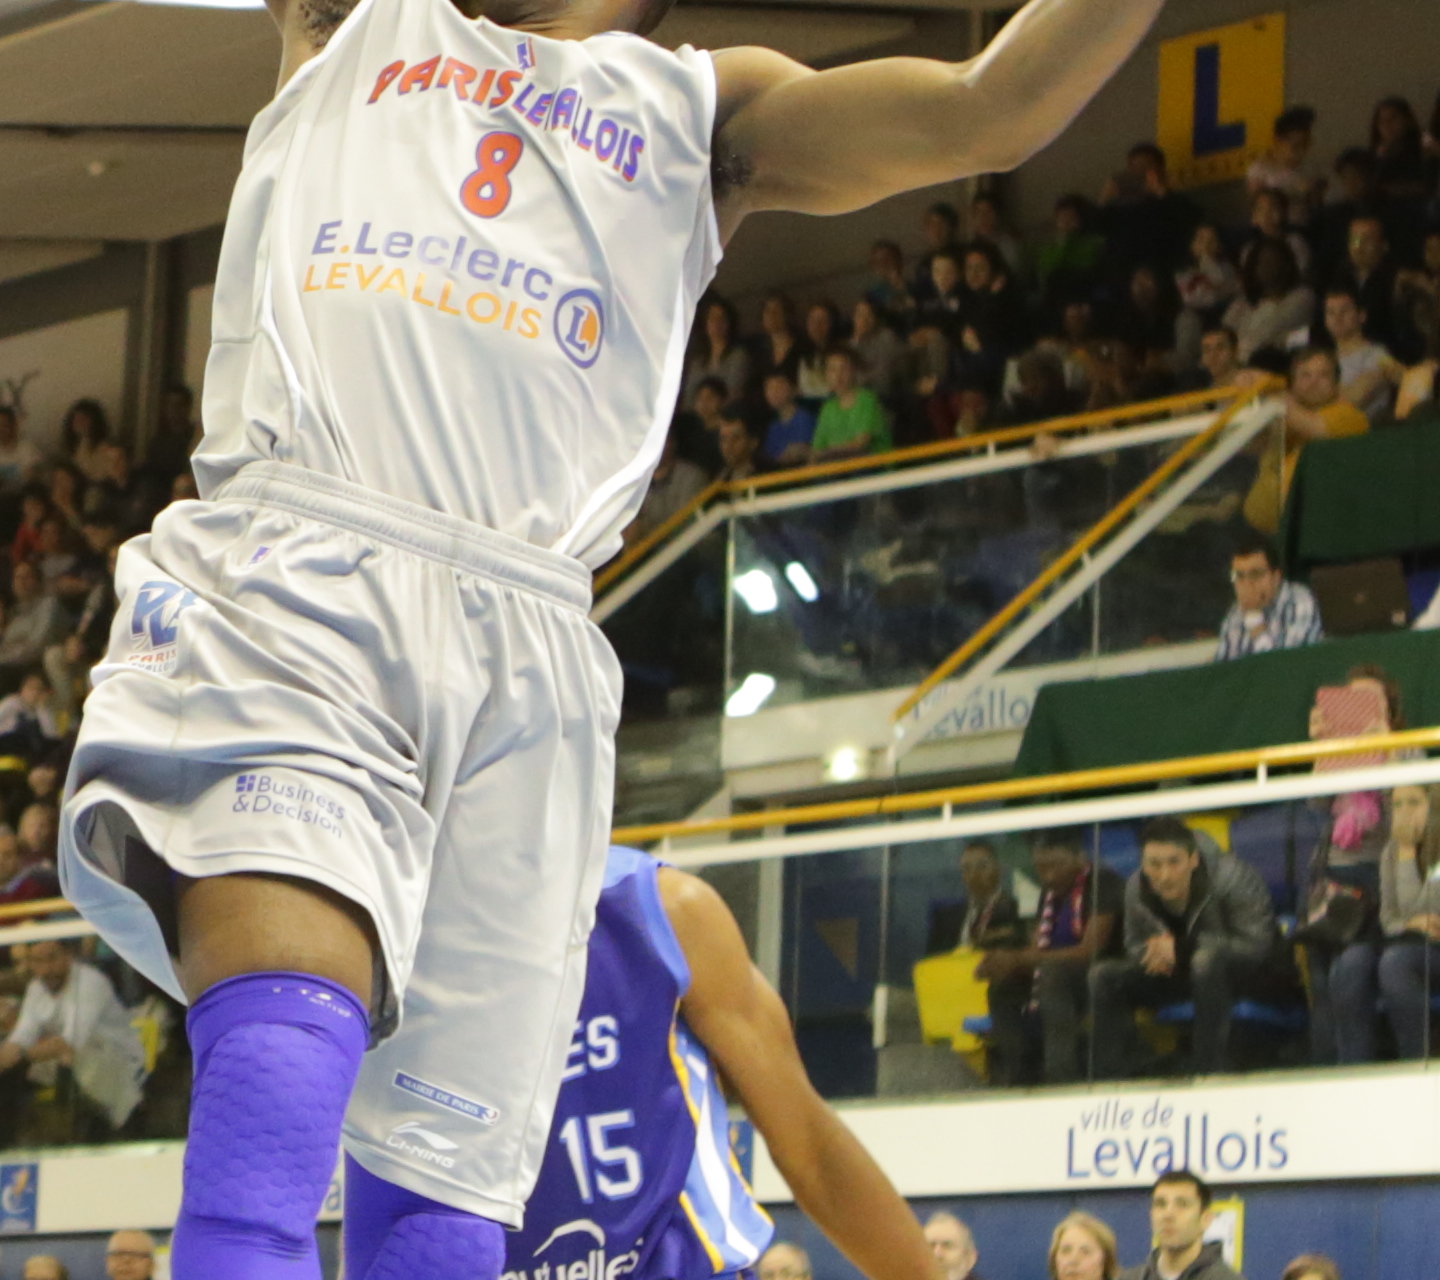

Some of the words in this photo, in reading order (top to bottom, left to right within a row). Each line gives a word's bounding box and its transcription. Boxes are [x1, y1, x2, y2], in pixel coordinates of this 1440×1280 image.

[367, 54, 523, 109] PARIS
[512, 82, 645, 182] LEALLOIS
[1194, 42, 1246, 156] L
[459, 130, 524, 218] 8
[311, 220, 553, 301] E.Leclerc
[302, 262, 542, 339] LEVALLOIS
[257, 775, 346, 820] Business
[385, 1135, 456, 1168] LI-NING
[1067, 1113, 1289, 1179] Levallois
[1081, 1098, 1134, 1132] ville
[1142, 1096, 1174, 1128] de
[559, 1108, 644, 1203] 15
